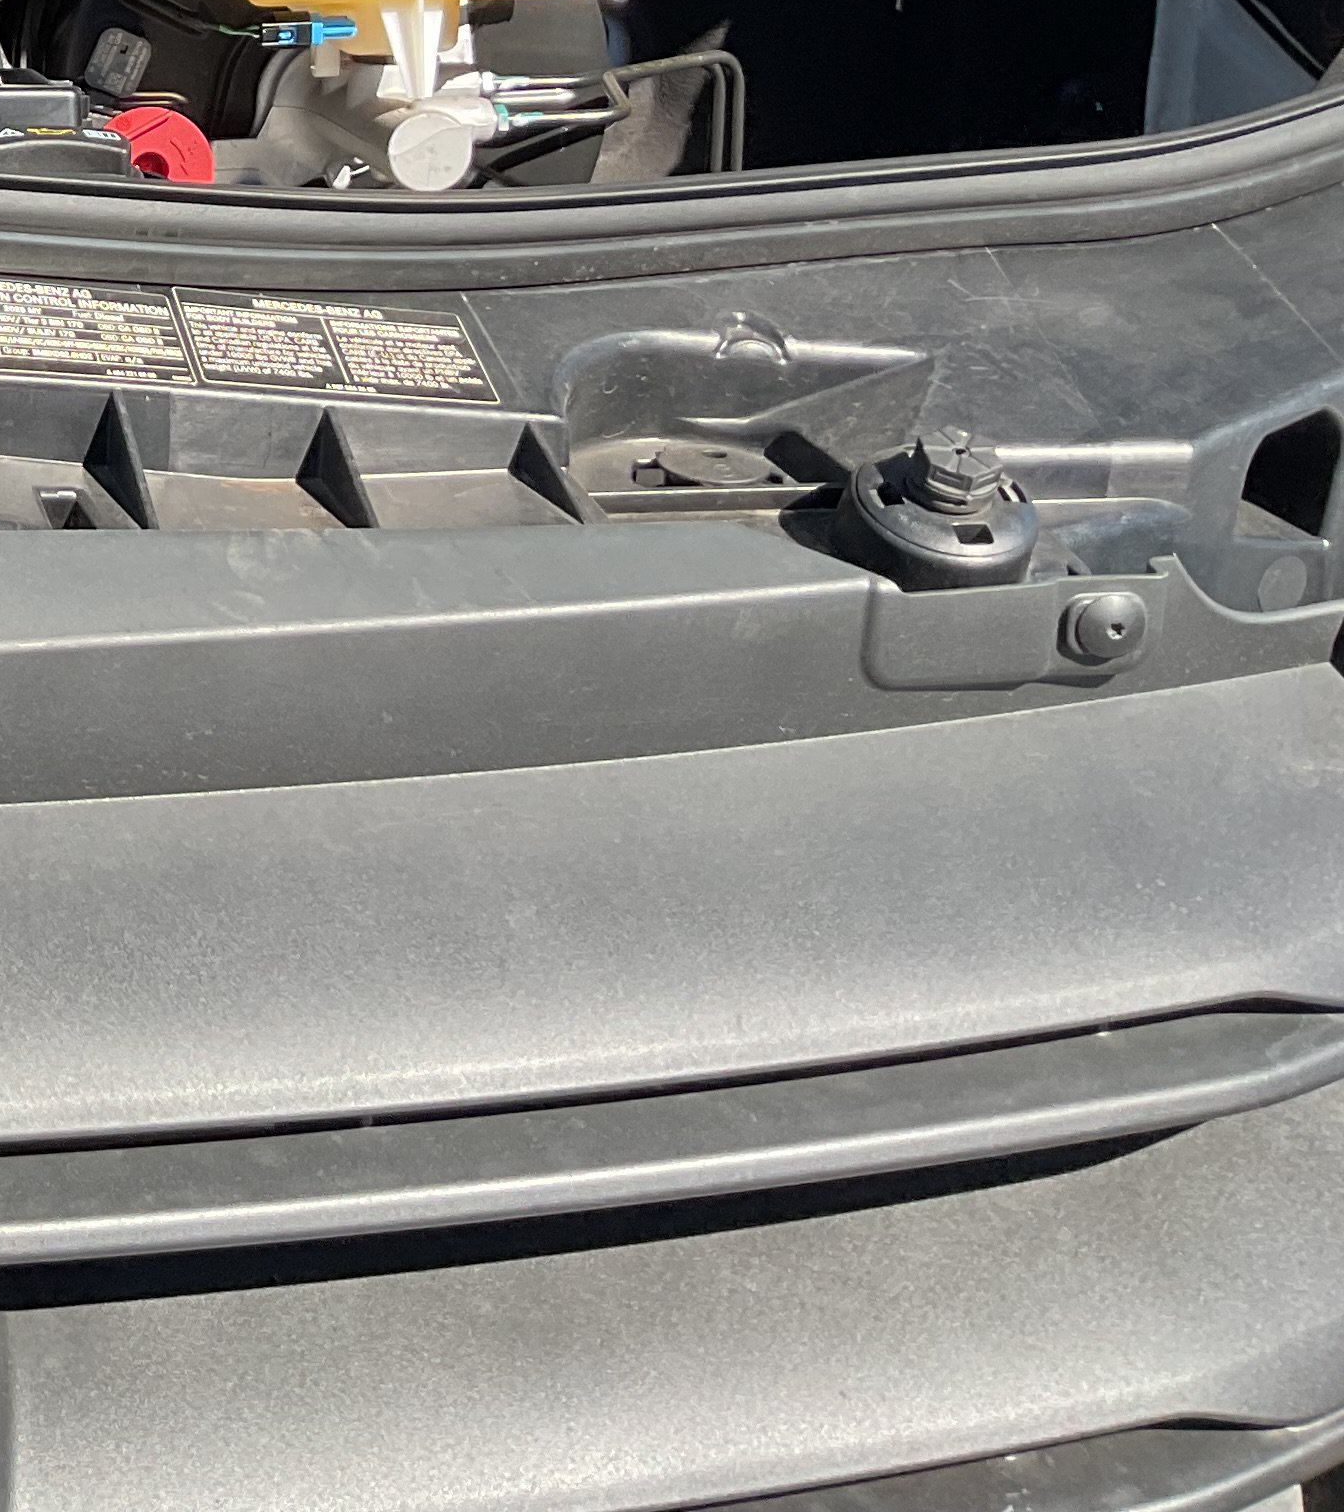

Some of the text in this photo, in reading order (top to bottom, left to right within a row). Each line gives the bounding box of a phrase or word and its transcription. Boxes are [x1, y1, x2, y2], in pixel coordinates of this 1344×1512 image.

[72, 289, 92, 299] AG
[13, 293, 76, 307] CONTROL
[78, 299, 169, 315] INFORMATION
[252, 299, 383, 319] MERCEDES-BENZ AG
[94, 311, 124, 321] Diesel
